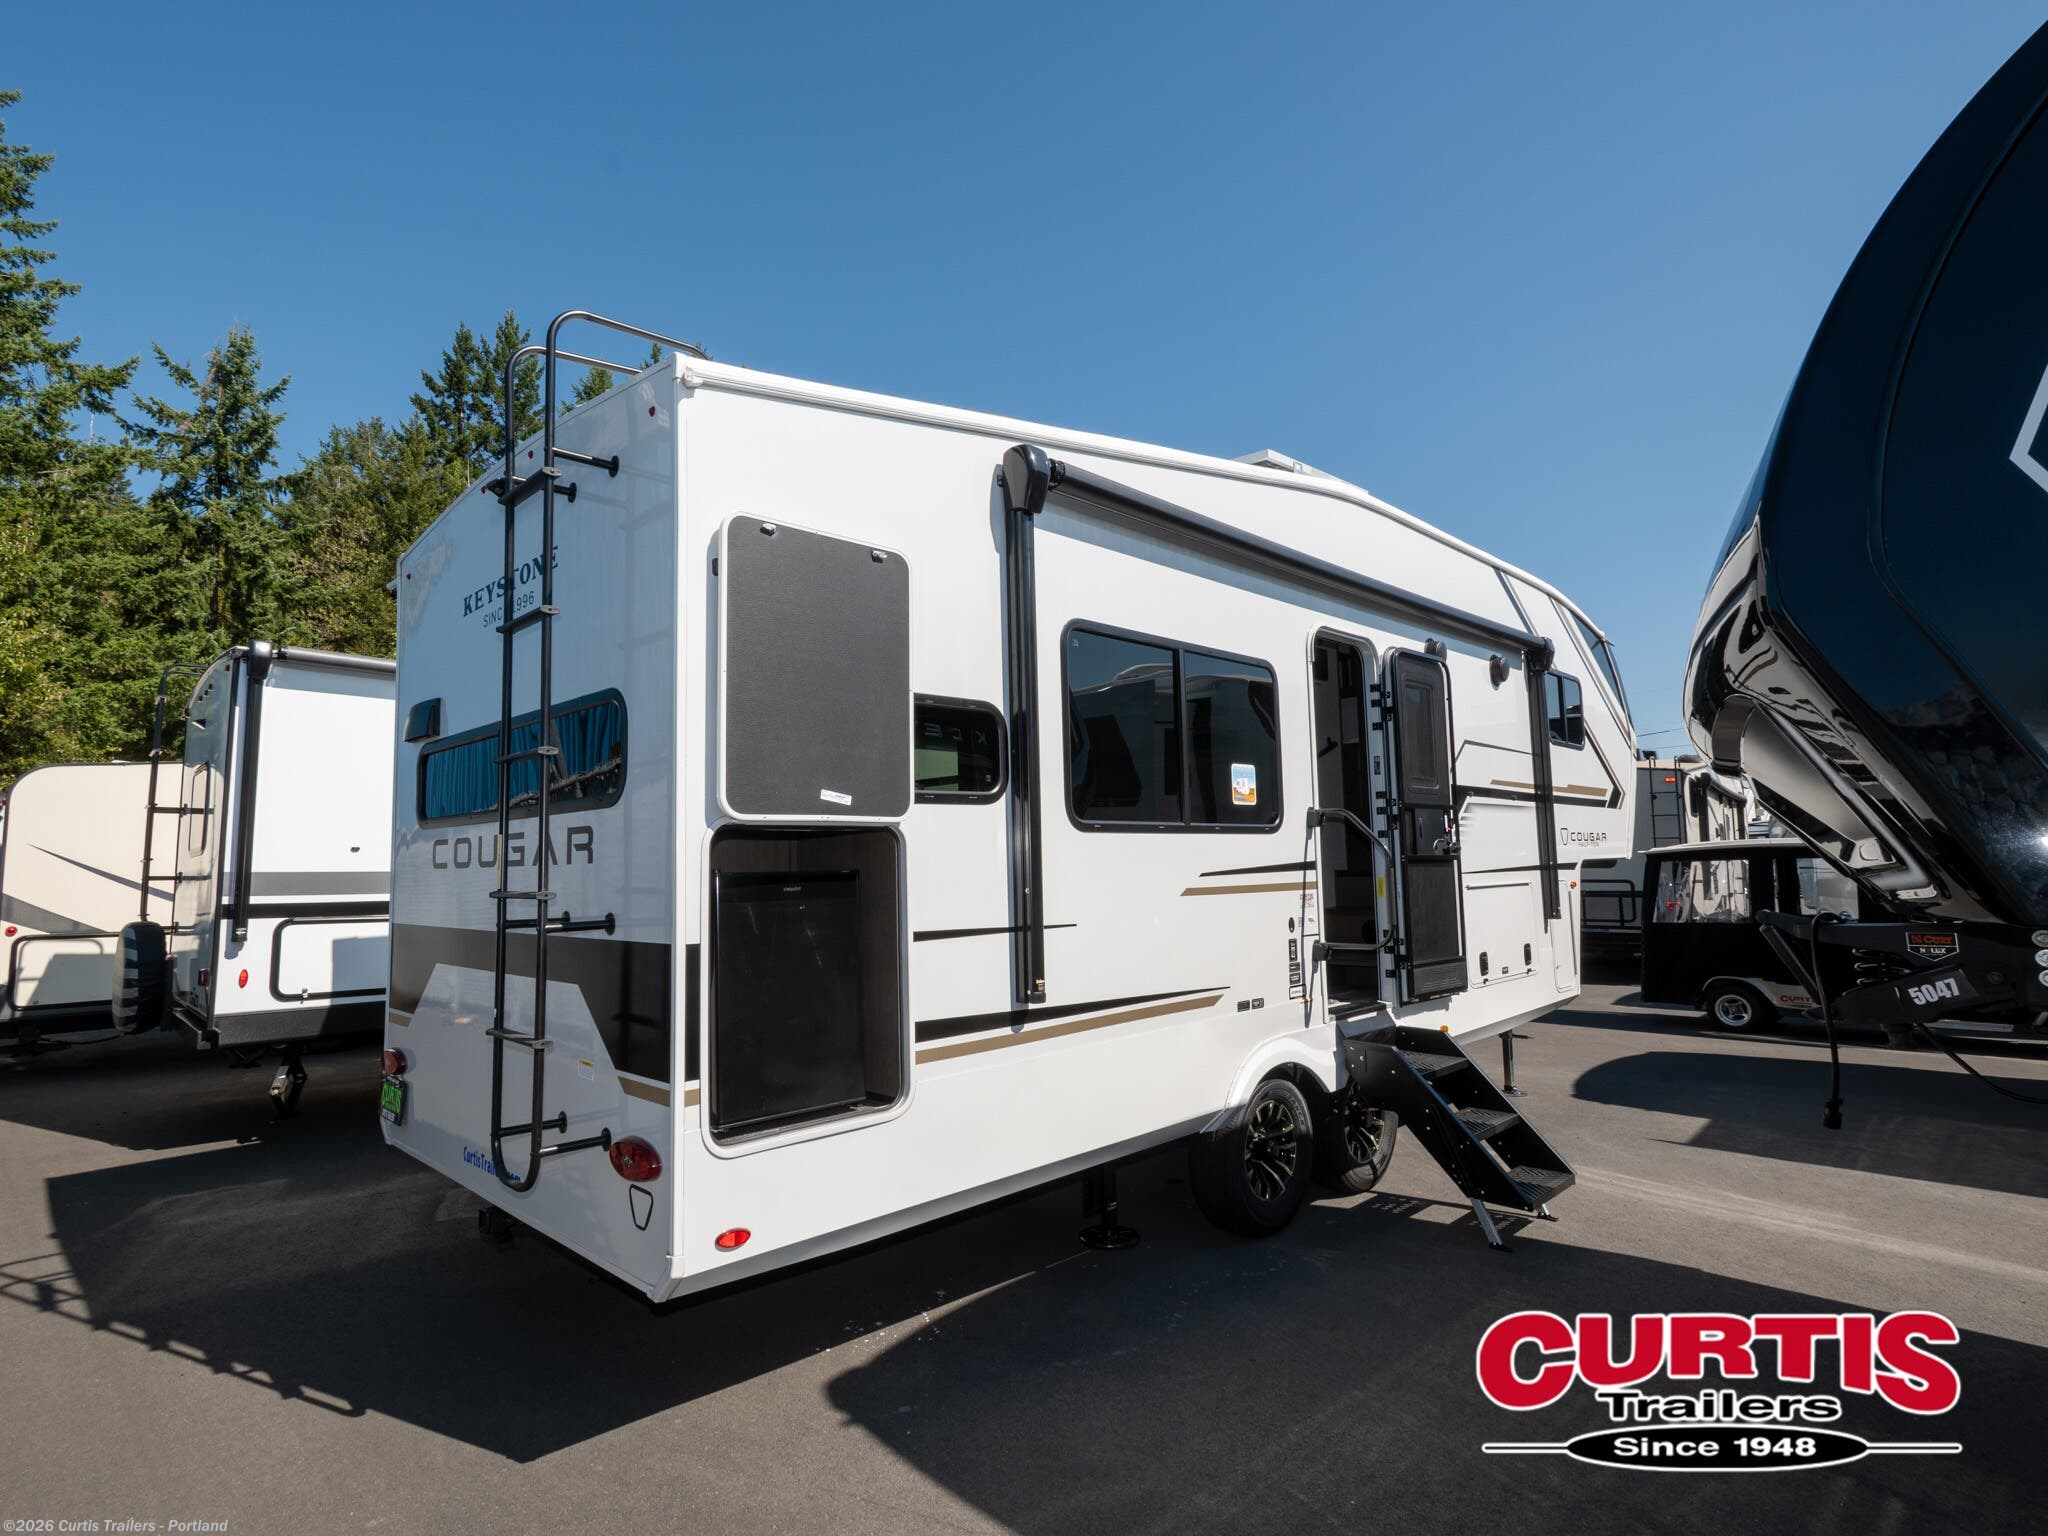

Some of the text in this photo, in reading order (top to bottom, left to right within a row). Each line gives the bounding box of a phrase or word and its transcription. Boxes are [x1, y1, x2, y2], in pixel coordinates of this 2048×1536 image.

[463, 545, 559, 617] KEYSONE
[483, 590, 535, 628] SINC 996
[1570, 831, 1607, 842] COUGAR
[1907, 977, 1960, 1005] 5047
